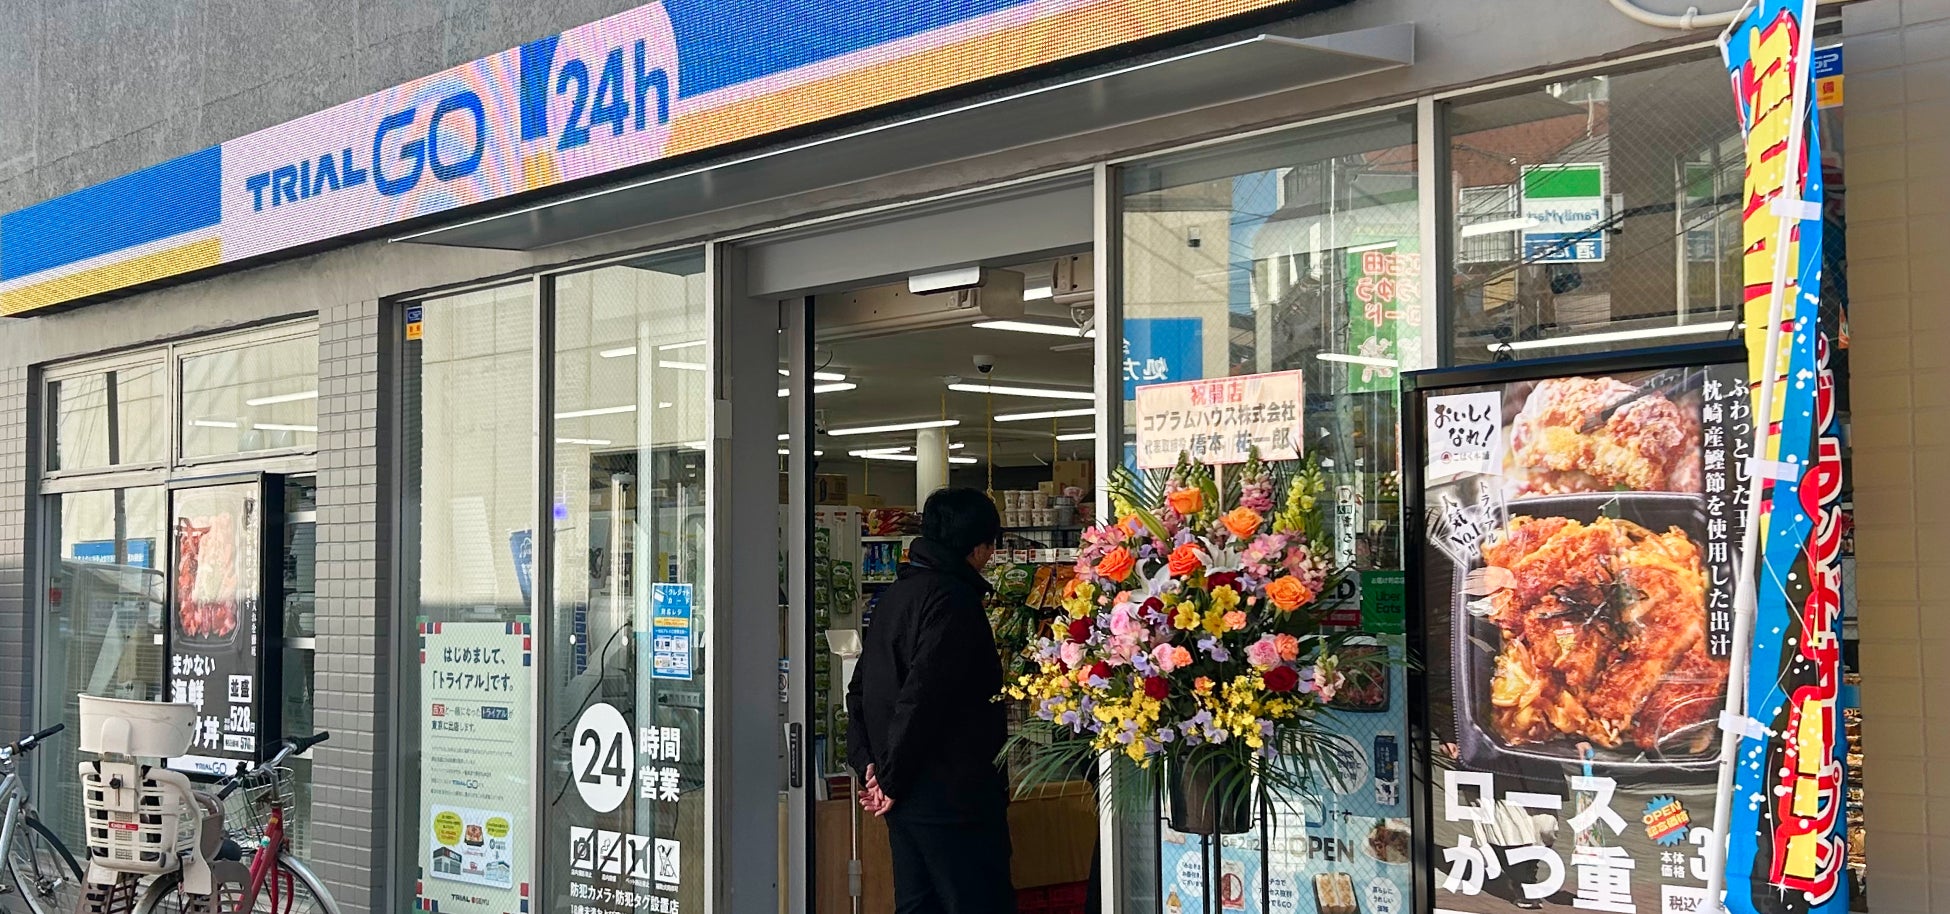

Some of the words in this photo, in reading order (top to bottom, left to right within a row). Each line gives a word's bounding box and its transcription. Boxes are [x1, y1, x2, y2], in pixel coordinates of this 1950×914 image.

[556, 38, 669, 151] 24h
[245, 147, 368, 212] TRIAL
[373, 90, 486, 196] GO
[1190, 381, 1243, 406] 祝開店
[1434, 404, 1491, 429] おいしく
[1190, 432, 1224, 456] 橋本
[1480, 481, 1498, 546] トライアル
[1702, 380, 1731, 656] 枕崎産鰹節を使用した出汁
[1375, 591, 1401, 602] Uber
[1375, 602, 1402, 614] Eats
[172, 653, 216, 676] まかない
[443, 646, 506, 665] はじめまして、
[432, 670, 514, 692] 「トライアル」です。
[639, 725, 681, 762] 時間
[579, 728, 627, 788] 24
[638, 765, 681, 803] 営業
[1444, 770, 1629, 837] ロース
[1643, 799, 1683, 825] OPEN
[1287, 834, 1356, 864] OPEN
[1660, 851, 1685, 865] 本体
[1442, 834, 1637, 914] かつ重
[1661, 864, 1686, 879] 価格
[570, 881, 680, 914] 防犯カメラ・防犯タグ設置店
